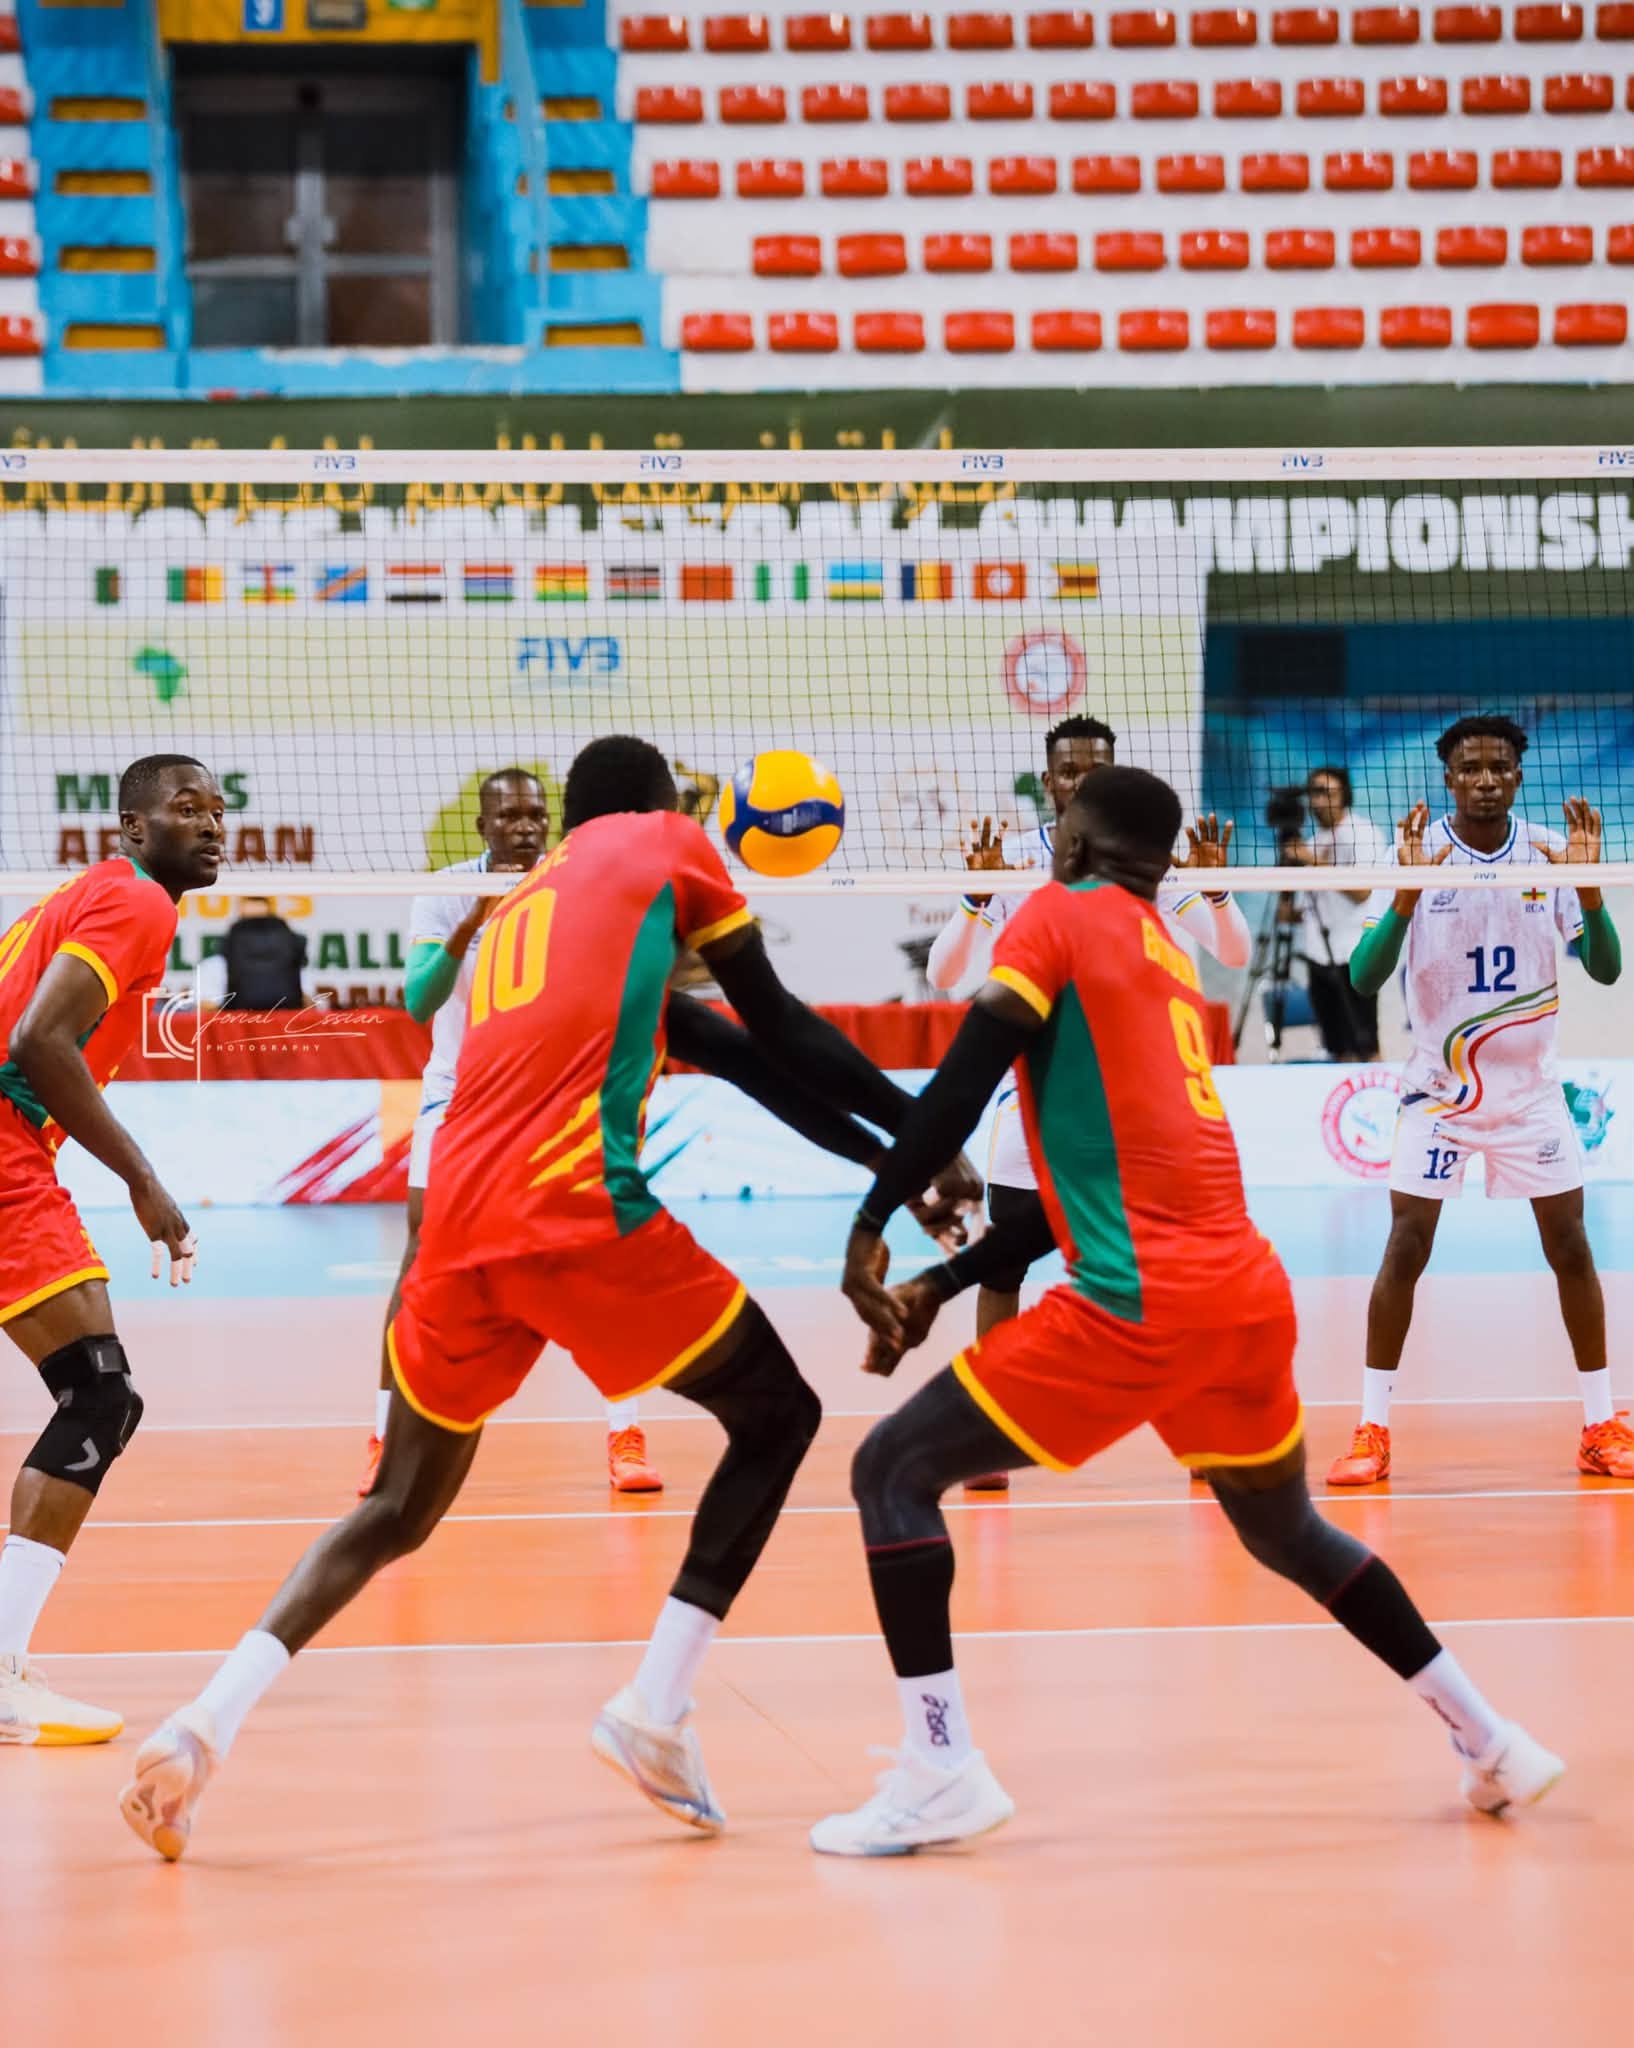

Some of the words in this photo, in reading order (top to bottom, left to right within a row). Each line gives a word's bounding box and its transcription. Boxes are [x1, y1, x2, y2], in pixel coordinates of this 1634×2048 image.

[58, 827, 315, 866] AFAN
[471, 887, 557, 1028] 10
[1466, 945, 1517, 993] 12
[1168, 996, 1226, 1121] 9
[1422, 1147, 1459, 1180] 12
